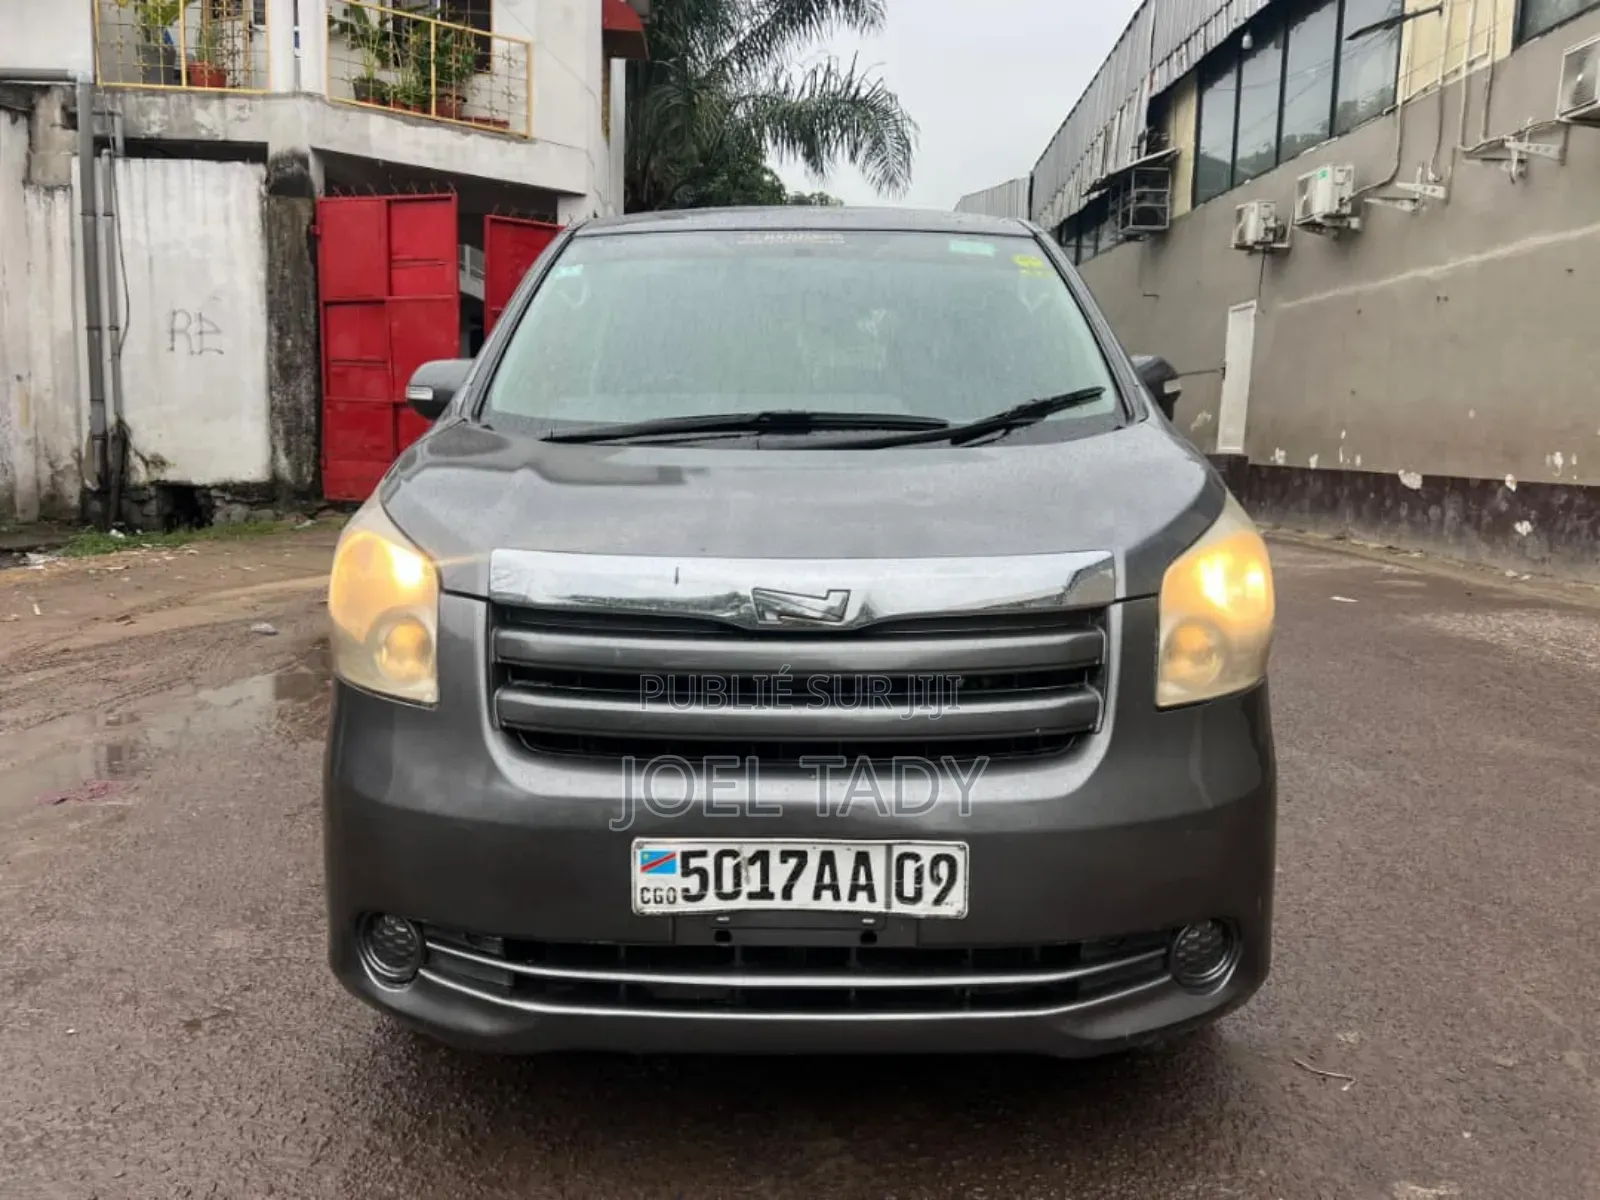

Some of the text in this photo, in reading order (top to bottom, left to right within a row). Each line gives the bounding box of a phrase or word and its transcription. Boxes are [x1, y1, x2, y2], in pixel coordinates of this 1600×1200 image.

[640, 886, 677, 905] CGO
[680, 848, 958, 907] 5017AA 09
